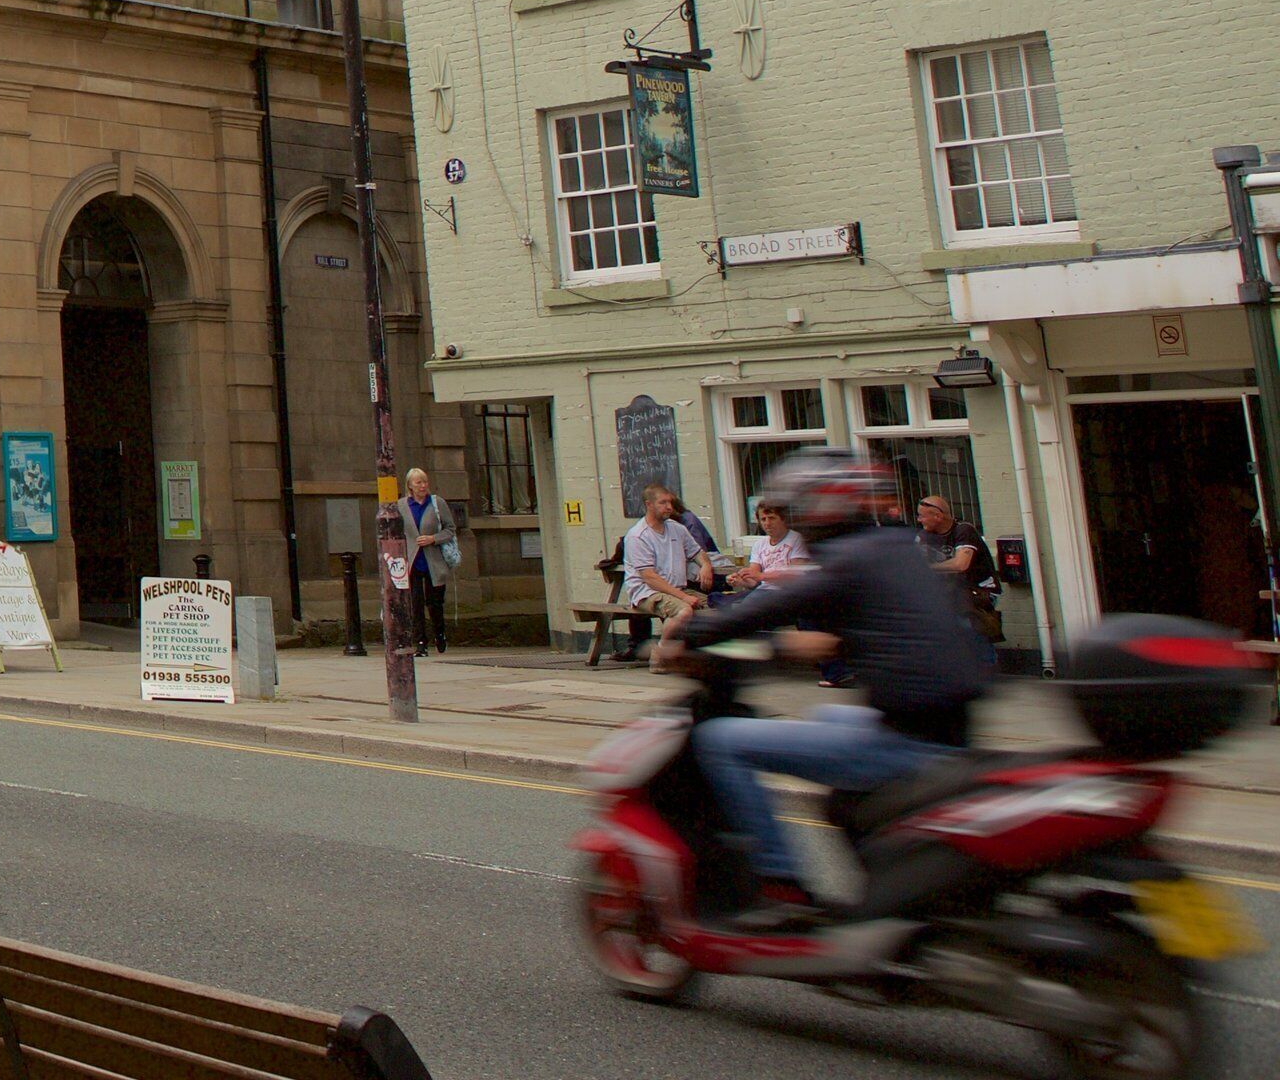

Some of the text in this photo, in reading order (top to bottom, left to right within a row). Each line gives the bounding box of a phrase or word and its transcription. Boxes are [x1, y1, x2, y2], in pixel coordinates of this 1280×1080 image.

[635, 73, 685, 94] PINEWOOD
[647, 90, 676, 104] TAVERN
[449, 160, 459, 171] H
[646, 163, 689, 177] Free House
[728, 233, 842, 257] BROAD STREET
[165, 464, 193, 472] MARKET
[567, 502, 582, 522] H
[142, 579, 231, 606] WELSHPOOL PETS
[27, 594, 37, 605] &
[177, 595, 195, 604] The
[168, 604, 204, 613] CARING
[163, 612, 210, 621] PET SHOP
[6, 630, 41, 641] Wares
[152, 627, 199, 635] LIVESTOCK
[170, 635, 220, 645] FOODSTUFF
[170, 644, 228, 654] ACCESSORIES
[171, 652, 193, 661] TOYS
[143, 670, 231, 684] 01938 555300
